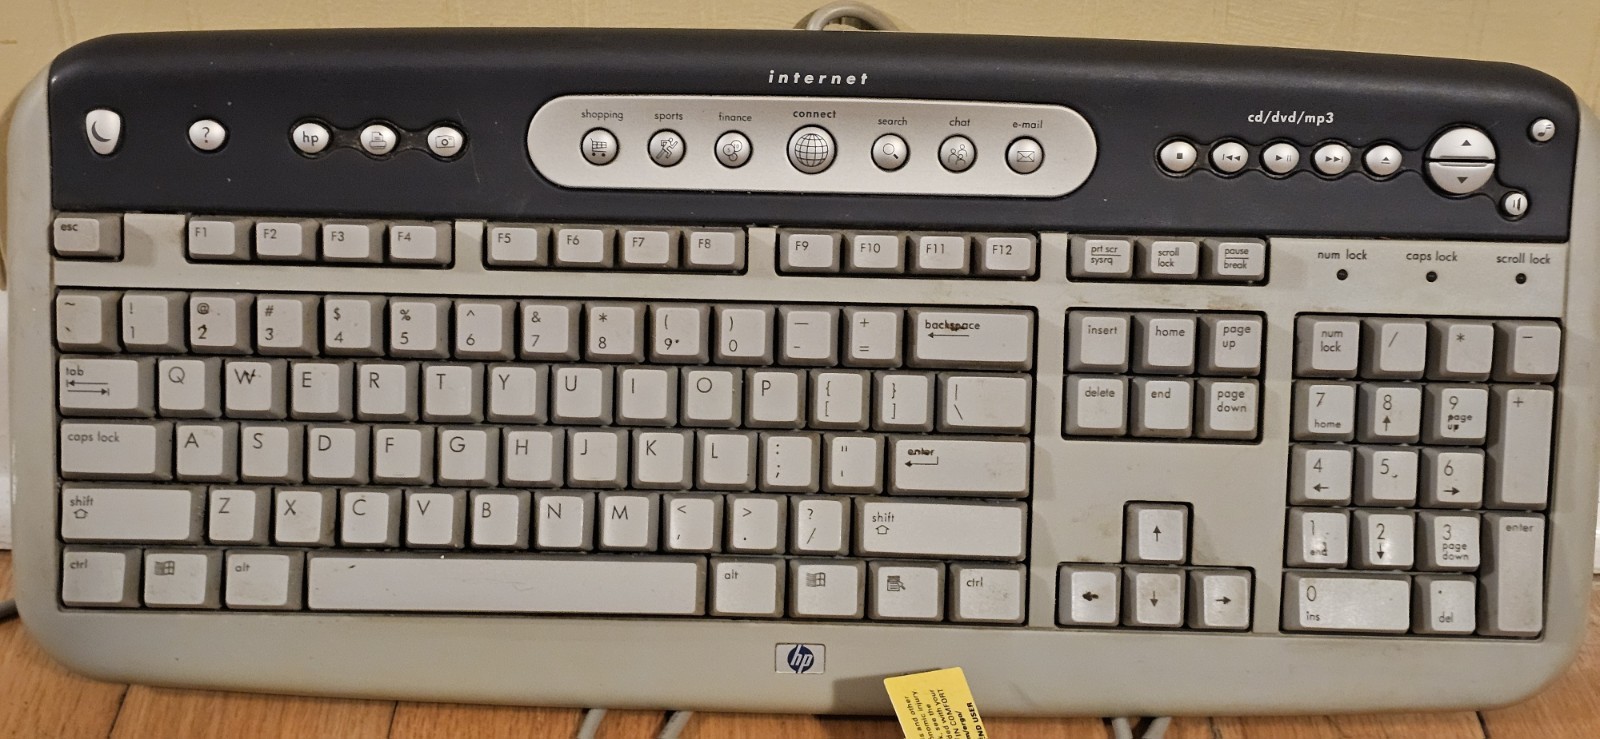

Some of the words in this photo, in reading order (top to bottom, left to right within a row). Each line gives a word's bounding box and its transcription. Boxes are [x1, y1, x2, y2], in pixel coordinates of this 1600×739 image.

[769, 70, 869, 86] internet
[582, 109, 623, 121] shopping
[654, 110, 684, 122] sports
[719, 112, 752, 121] finance
[793, 110, 836, 118] connect
[1248, 110, 1334, 126] cd/dvd/mp3
[878, 117, 907, 125] search
[949, 117, 970, 126] chat
[1013, 120, 1042, 128] e-mail
[201, 126, 209, 143] ?
[302, 130, 319, 146] hp
[195, 227, 206, 237] F1
[264, 229, 276, 239] F2
[332, 231, 344, 241] F3
[398, 232, 411, 241] F4
[498, 233, 511, 243] F5
[567, 235, 579, 245] F6
[633, 237, 645, 247] F7
[699, 239, 711, 248] F8
[796, 241, 808, 250] F9
[861, 243, 880, 253] F10
[926, 244, 944, 254] F11
[993, 245, 1012, 255] F12
[1091, 246, 1106, 256] prt
[1158, 247, 1179, 256] scroll
[1224, 248, 1250, 257] pause
[1346, 249, 1367, 260] lock
[1406, 253, 1431, 263] caps
[1435, 251, 1457, 261] lock
[1497, 253, 1525, 263] scroll
[1529, 253, 1551, 265] lock
[1158, 258, 1174, 267] lock
[1224, 258, 1249, 269] break
[197, 303, 209, 315] @
[265, 306, 273, 316] #
[334, 308, 341, 320] $
[400, 309, 411, 321] %
[532, 311, 541, 323] &
[860, 318, 869, 327] +
[198, 325, 207, 339] 2
[925, 320, 980, 332] backspace
[1088, 325, 1117, 334] insert
[1156, 326, 1185, 336] home
[1223, 327, 1251, 336] page
[265, 328, 273, 340] 3
[334, 332, 343, 343] 4
[400, 332, 408, 344] 5
[466, 334, 475, 345] 6
[1322, 330, 1343, 338] num
[1388, 332, 1398, 347] /
[532, 335, 540, 346] 7
[599, 337, 606, 349] 8
[664, 338, 672, 350] 9
[729, 340, 737, 352] 0
[1223, 341, 1235, 349] up
[1321, 341, 1341, 352] lock
[66, 365, 84, 376] tab
[168, 367, 185, 384] Q
[235, 369, 256, 384] W
[302, 372, 311, 387] E
[370, 372, 379, 388] R
[436, 374, 446, 389] T
[499, 374, 510, 390] Y
[565, 376, 577, 391] U
[697, 377, 712, 393] O
[762, 380, 771, 396] P
[1085, 387, 1115, 397] delete
[1151, 388, 1171, 398] end
[1218, 391, 1245, 401] page
[1316, 392, 1325, 407] 7
[1513, 397, 1524, 407] +
[1217, 402, 1246, 412] down
[1383, 395, 1392, 410] 8
[1449, 396, 1458, 410] 9
[1315, 419, 1341, 428] home
[1448, 415, 1472, 423] page
[68, 434, 93, 443] caps
[98, 432, 119, 442] lock
[184, 433, 199, 448] A
[253, 433, 263, 449] S
[318, 435, 331, 451] D
[386, 437, 394, 453] F
[450, 436, 465, 452] G
[516, 439, 528, 455] H
[580, 439, 588, 455] J
[647, 440, 656, 456] K
[711, 443, 719, 458] L
[1313, 458, 1322, 472] 4
[1380, 459, 1389, 474] 5
[1444, 460, 1453, 476] 6
[70, 496, 93, 506] shift
[219, 498, 230, 514] Z
[353, 499, 366, 515] C
[284, 500, 296, 515] X
[417, 500, 430, 515] V
[482, 502, 491, 518] B
[548, 503, 561, 519] N
[612, 506, 628, 520] M
[677, 505, 686, 513] <
[743, 508, 752, 517] >
[807, 509, 814, 519] ?
[873, 512, 894, 522] shift
[1377, 523, 1385, 539] 2
[1443, 524, 1451, 540] 3
[1506, 524, 1533, 532] enter
[807, 528, 816, 544] /
[1443, 543, 1467, 554] page
[1443, 551, 1469, 560] down
[70, 559, 87, 569] ctrl
[235, 562, 250, 572] alt
[725, 569, 738, 579] alt
[967, 577, 983, 587] ctrl
[1307, 585, 1316, 601] 0
[1306, 611, 1320, 621] ins
[1439, 612, 1453, 623] del
[790, 644, 814, 674] hp
[912, 691, 923, 711] injury
[929, 689, 941, 706] your
[904, 696, 916, 715] other
[926, 704, 934, 716] the
[937, 689, 957, 726] COMFORT
[936, 707, 946, 723] with
[966, 702, 979, 723] USER
[912, 717, 922, 731] and
[931, 718, 940, 731] see
[953, 728, 962, 737] IN
